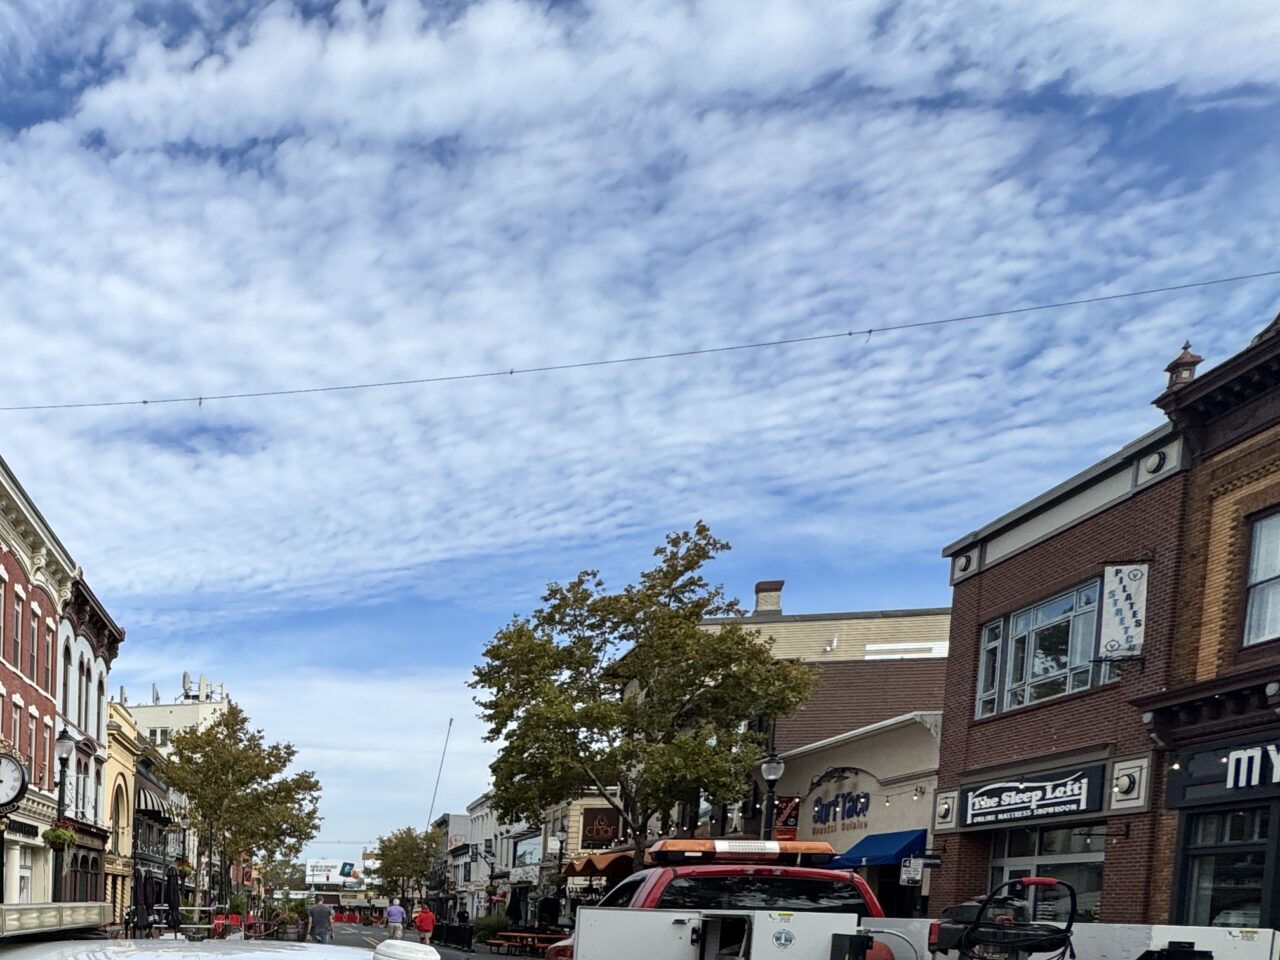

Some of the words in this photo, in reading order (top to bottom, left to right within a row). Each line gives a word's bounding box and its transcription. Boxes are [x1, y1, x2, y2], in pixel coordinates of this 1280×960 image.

[1115, 568, 1142, 628] PILATES
[1107, 589, 1136, 652] STRETCH
[813, 793, 840, 825] Surf
[841, 791, 871, 820] Taco
[973, 797, 999, 810] The
[1001, 789, 1042, 809] Sleep
[1045, 781, 1081, 800] Loft
[998, 810, 1031, 820] MATTRESS
[1033, 804, 1078, 816] SHOWROOM
